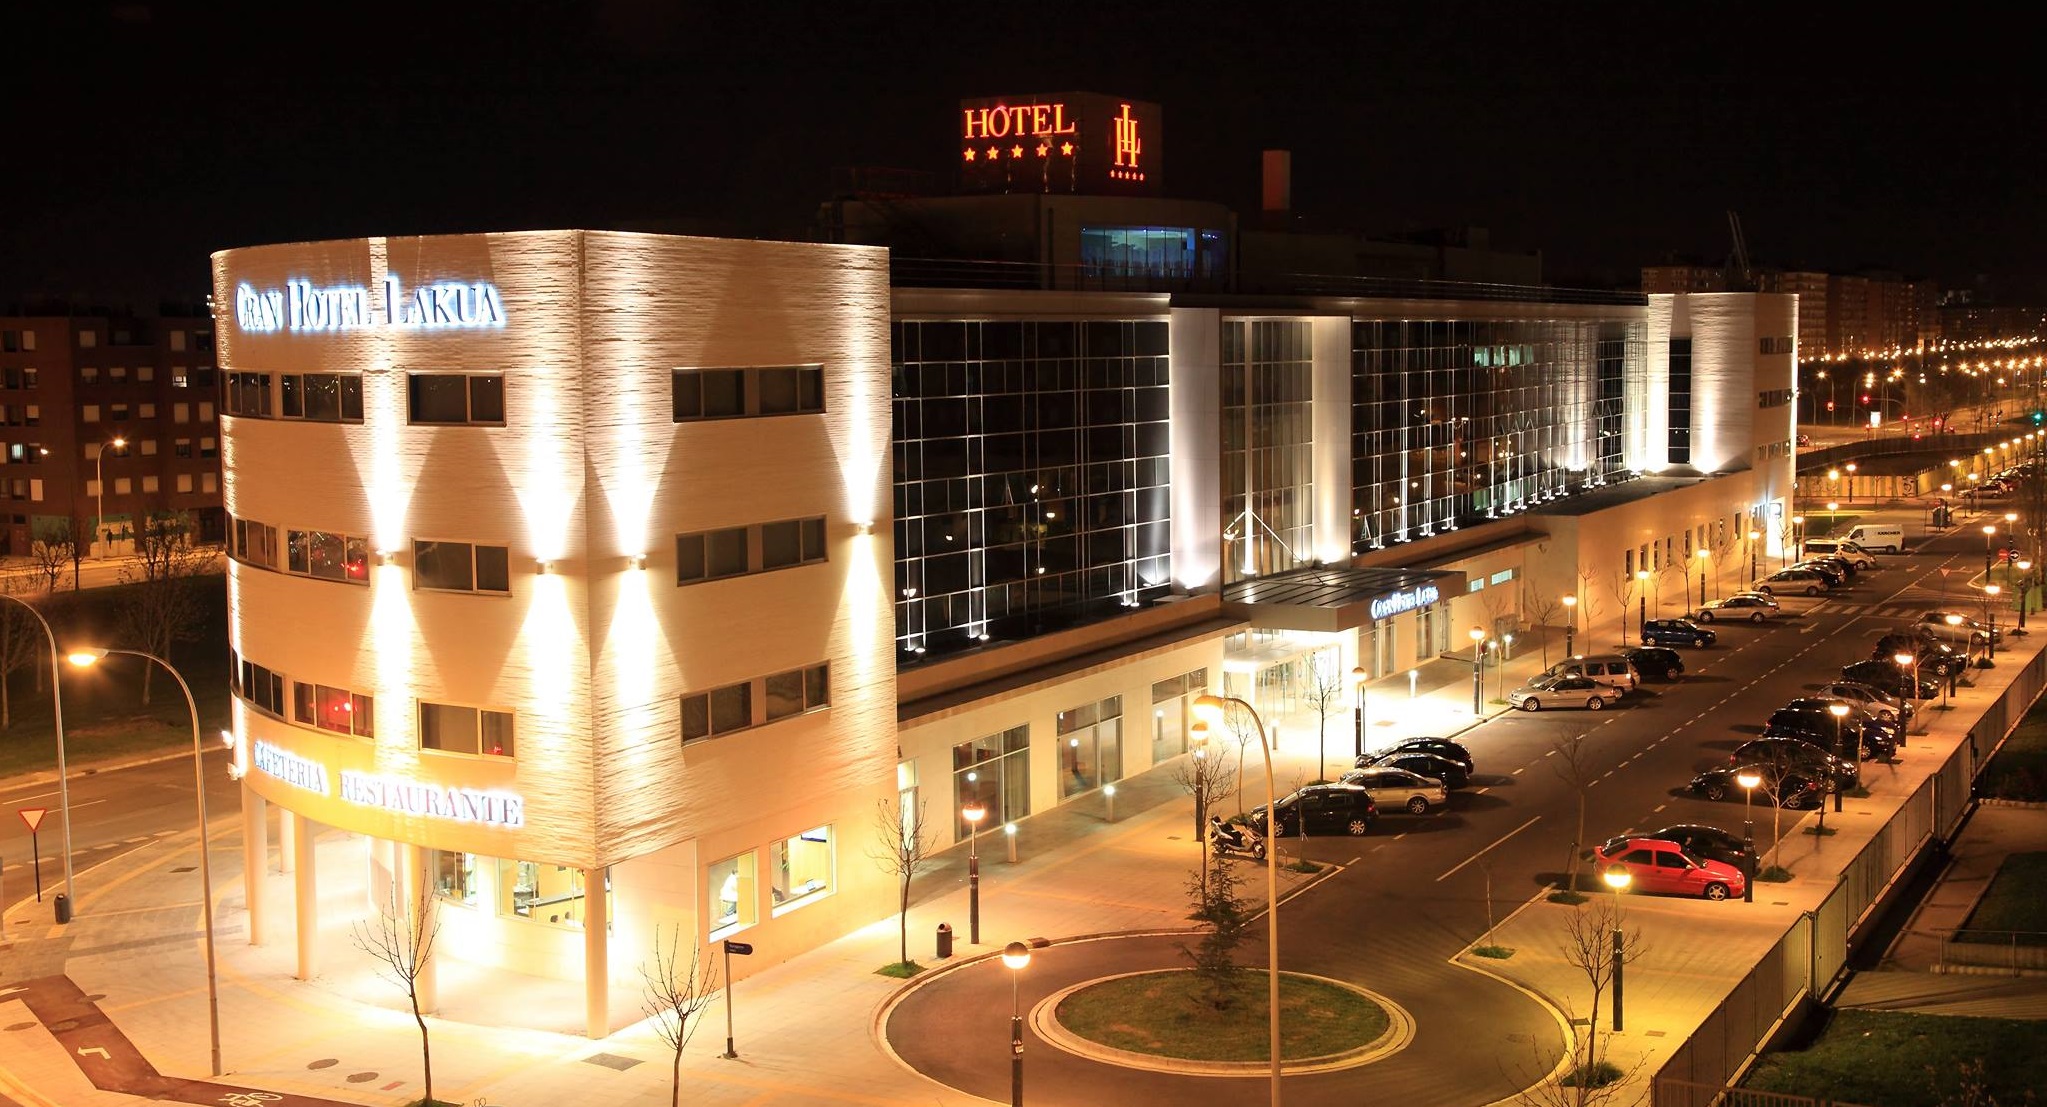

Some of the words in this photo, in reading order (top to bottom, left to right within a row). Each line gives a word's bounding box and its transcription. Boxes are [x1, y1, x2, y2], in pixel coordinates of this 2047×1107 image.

[964, 104, 1075, 138] HOTEL
[235, 282, 283, 330] GRAN
[286, 279, 372, 329] HOTEL
[383, 274, 504, 327] LAKUA
[253, 741, 325, 794] CAFETERIA
[339, 770, 520, 826] RESTAURANTE
